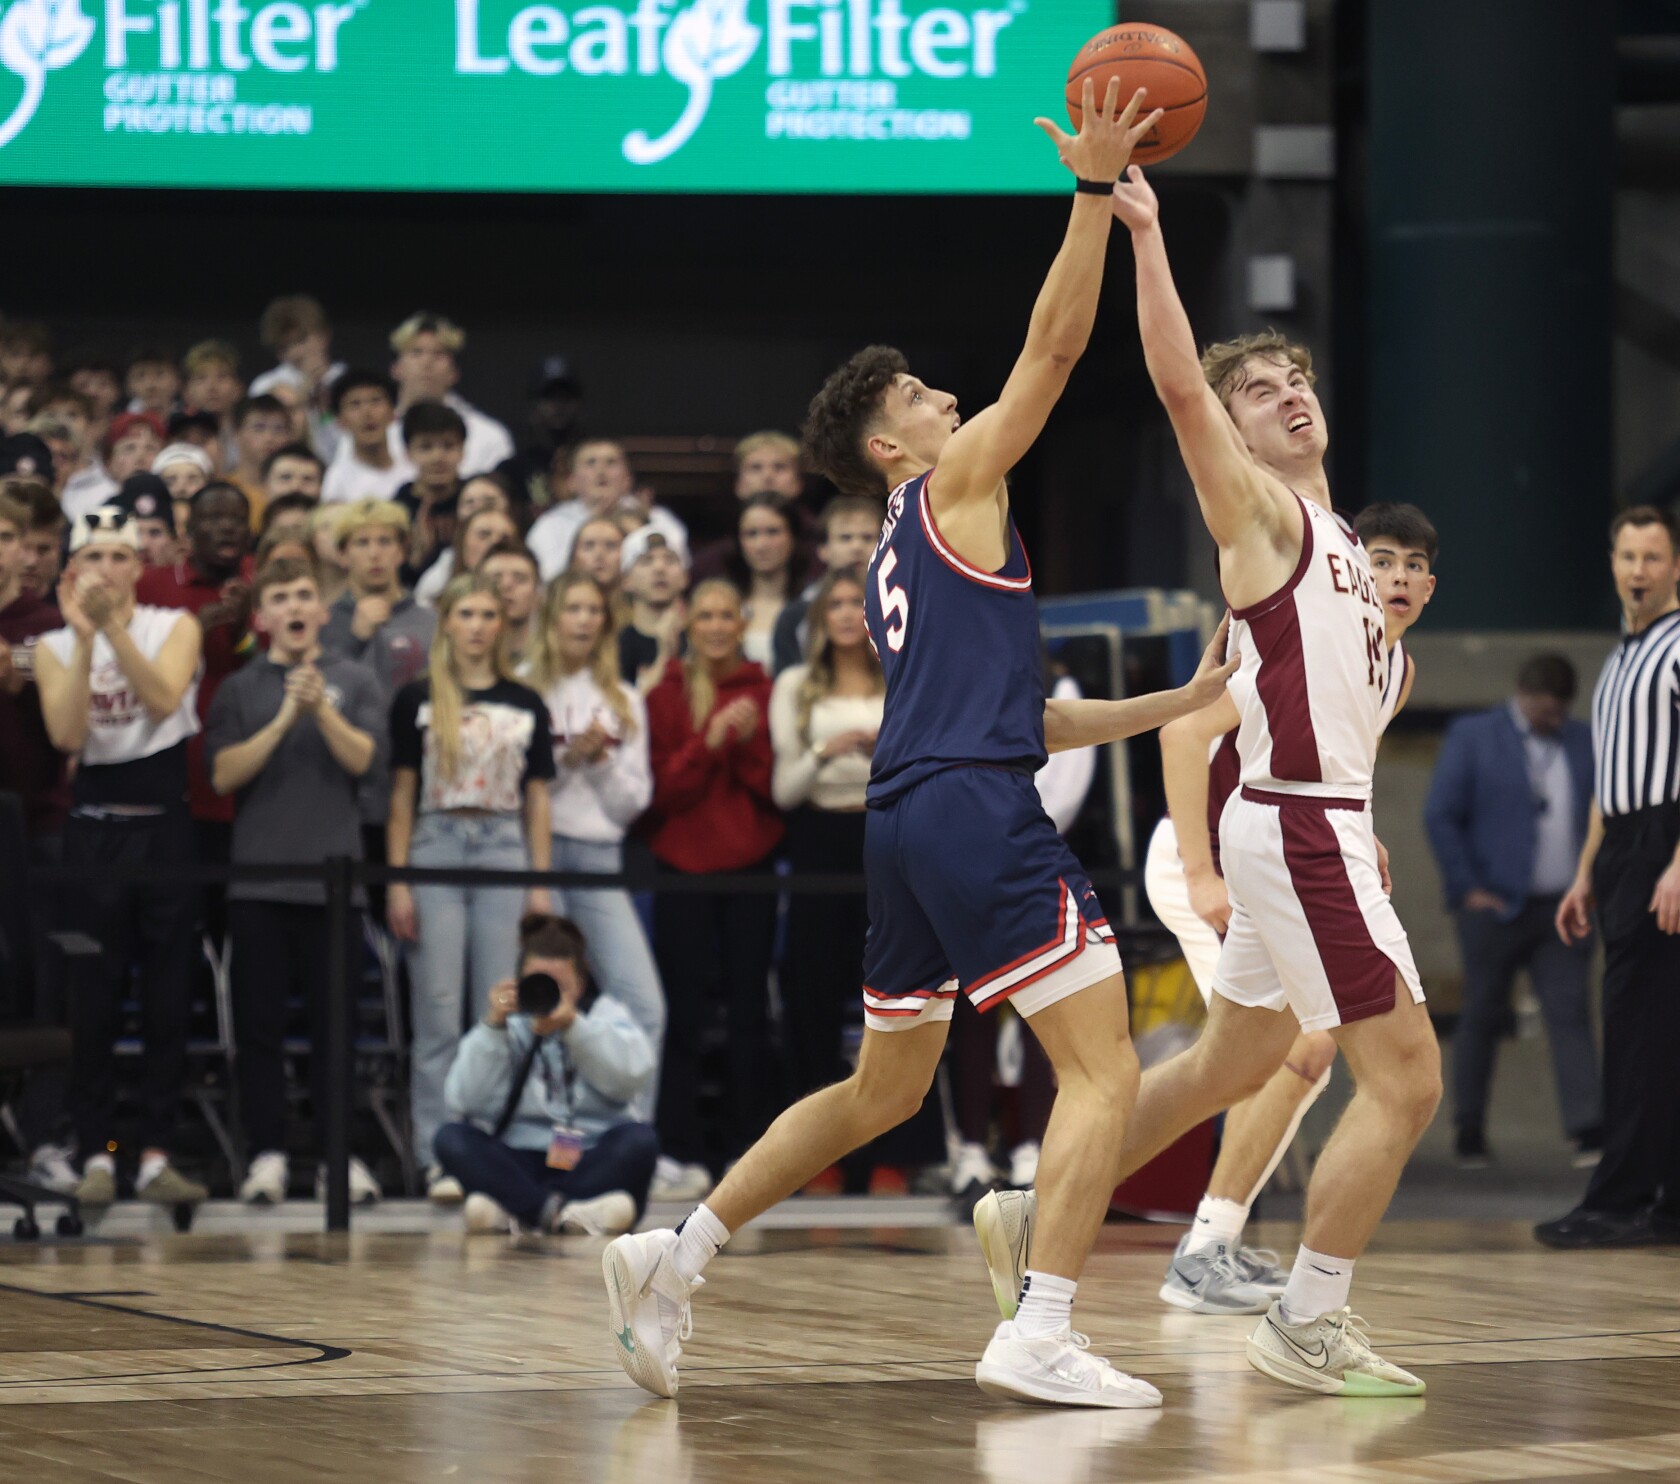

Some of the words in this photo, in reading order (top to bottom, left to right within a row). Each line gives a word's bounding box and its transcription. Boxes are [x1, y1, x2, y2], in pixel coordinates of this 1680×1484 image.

[103, 0, 356, 72] Filter
[103, 74, 236, 102] GUTTER
[766, 80, 897, 109] GUTTER
[103, 103, 312, 133] PROTECTION
[766, 110, 971, 140] PROTECTION
